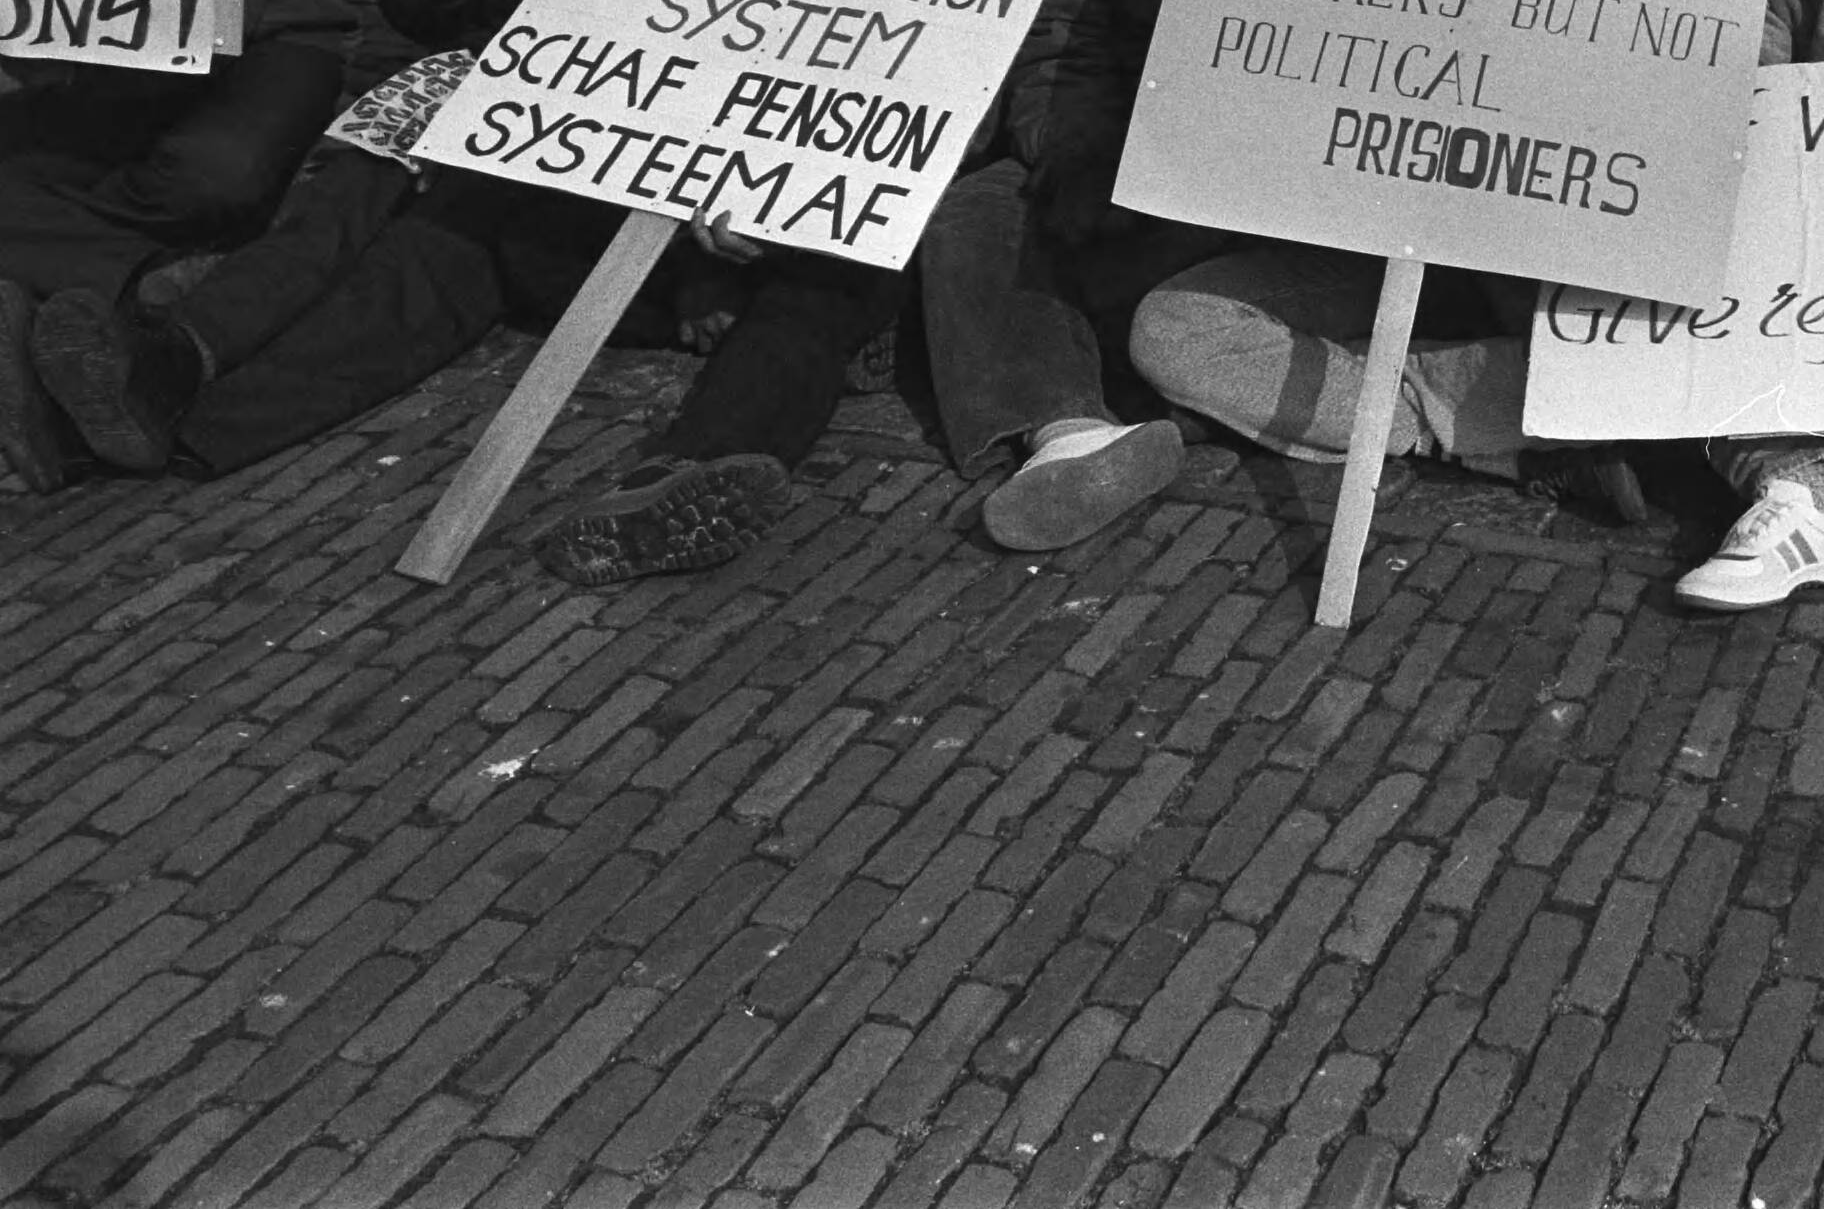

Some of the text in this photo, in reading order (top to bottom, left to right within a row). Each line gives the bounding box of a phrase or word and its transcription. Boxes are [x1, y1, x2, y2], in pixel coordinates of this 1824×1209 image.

[1210, 15, 1503, 114] POLITICAL
[1629, 2, 1740, 68] NOT
[480, 25, 698, 112] SCHAF
[713, 70, 952, 173] PENSION
[465, 100, 794, 225] SYSTEEM
[779, 173, 911, 248] AF
[1323, 106, 1647, 218] PRISONERS
